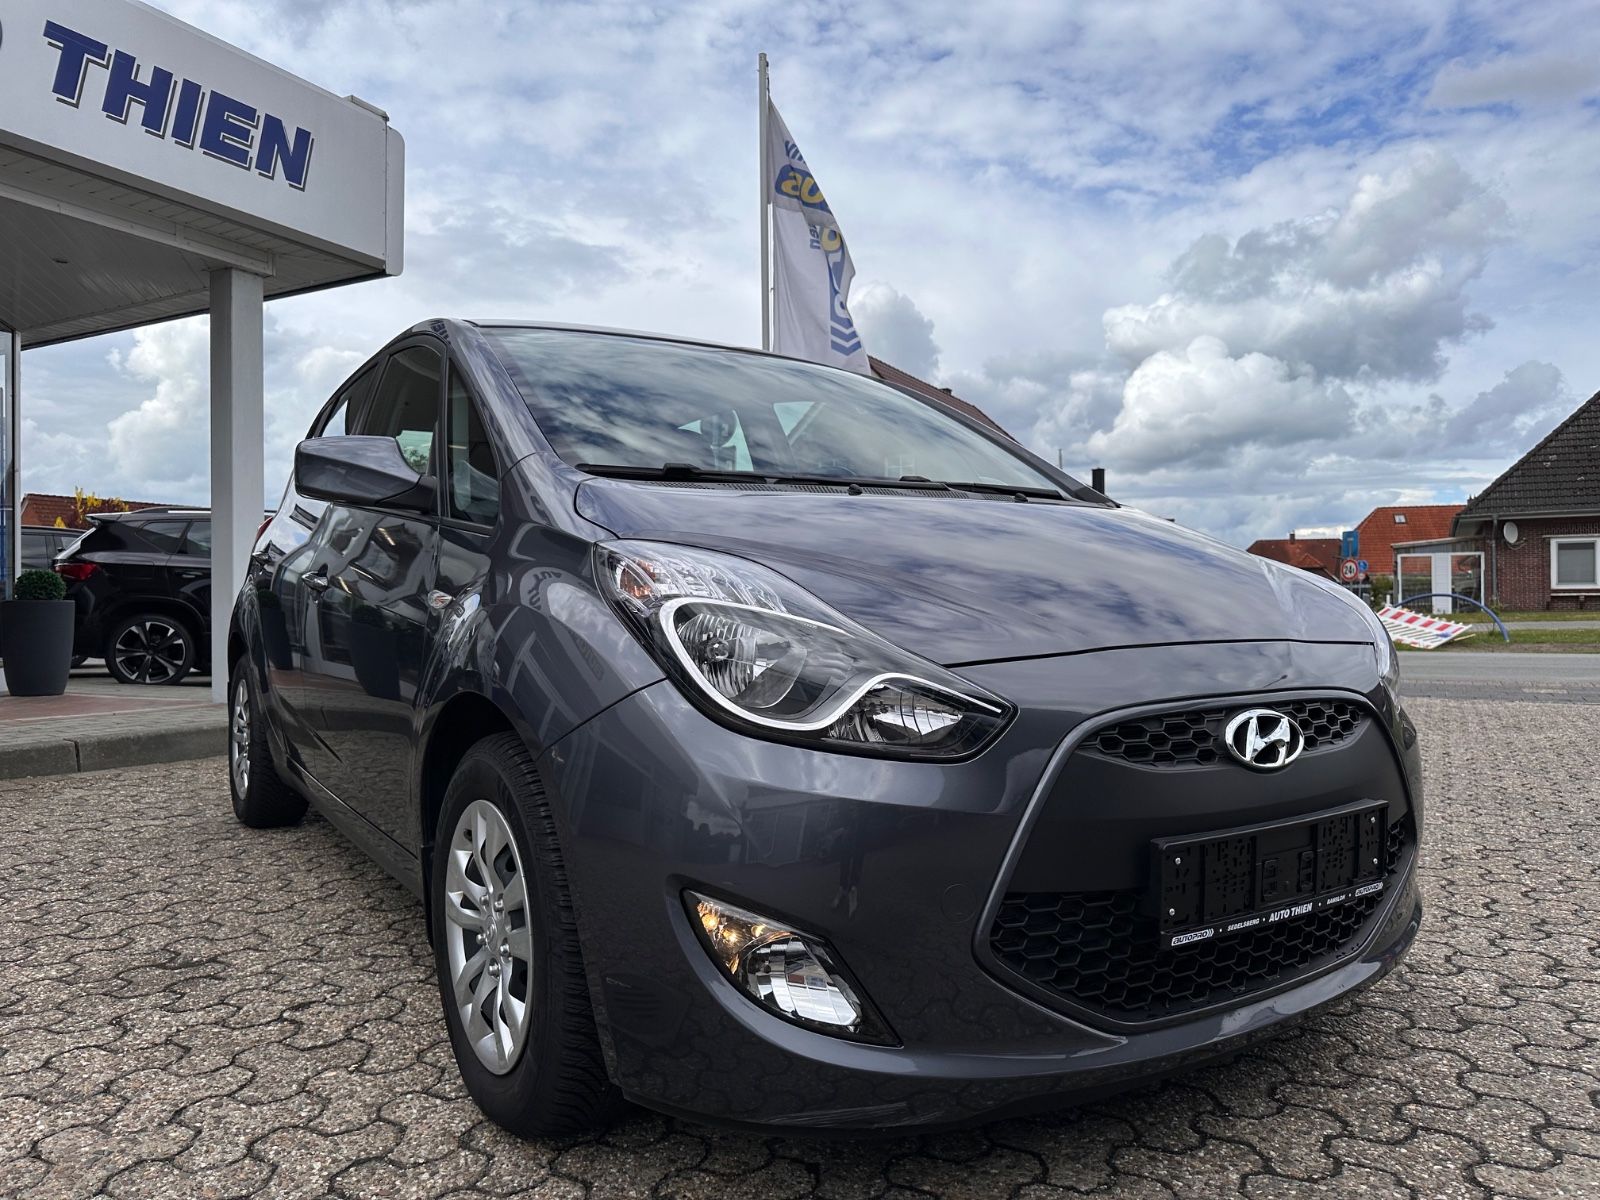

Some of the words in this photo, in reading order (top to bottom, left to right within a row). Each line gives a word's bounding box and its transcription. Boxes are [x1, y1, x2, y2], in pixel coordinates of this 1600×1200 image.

[43, 20, 314, 191] THIEN
[1268, 909, 1290, 922] AUTO
[1291, 902, 1313, 917] THIEN
